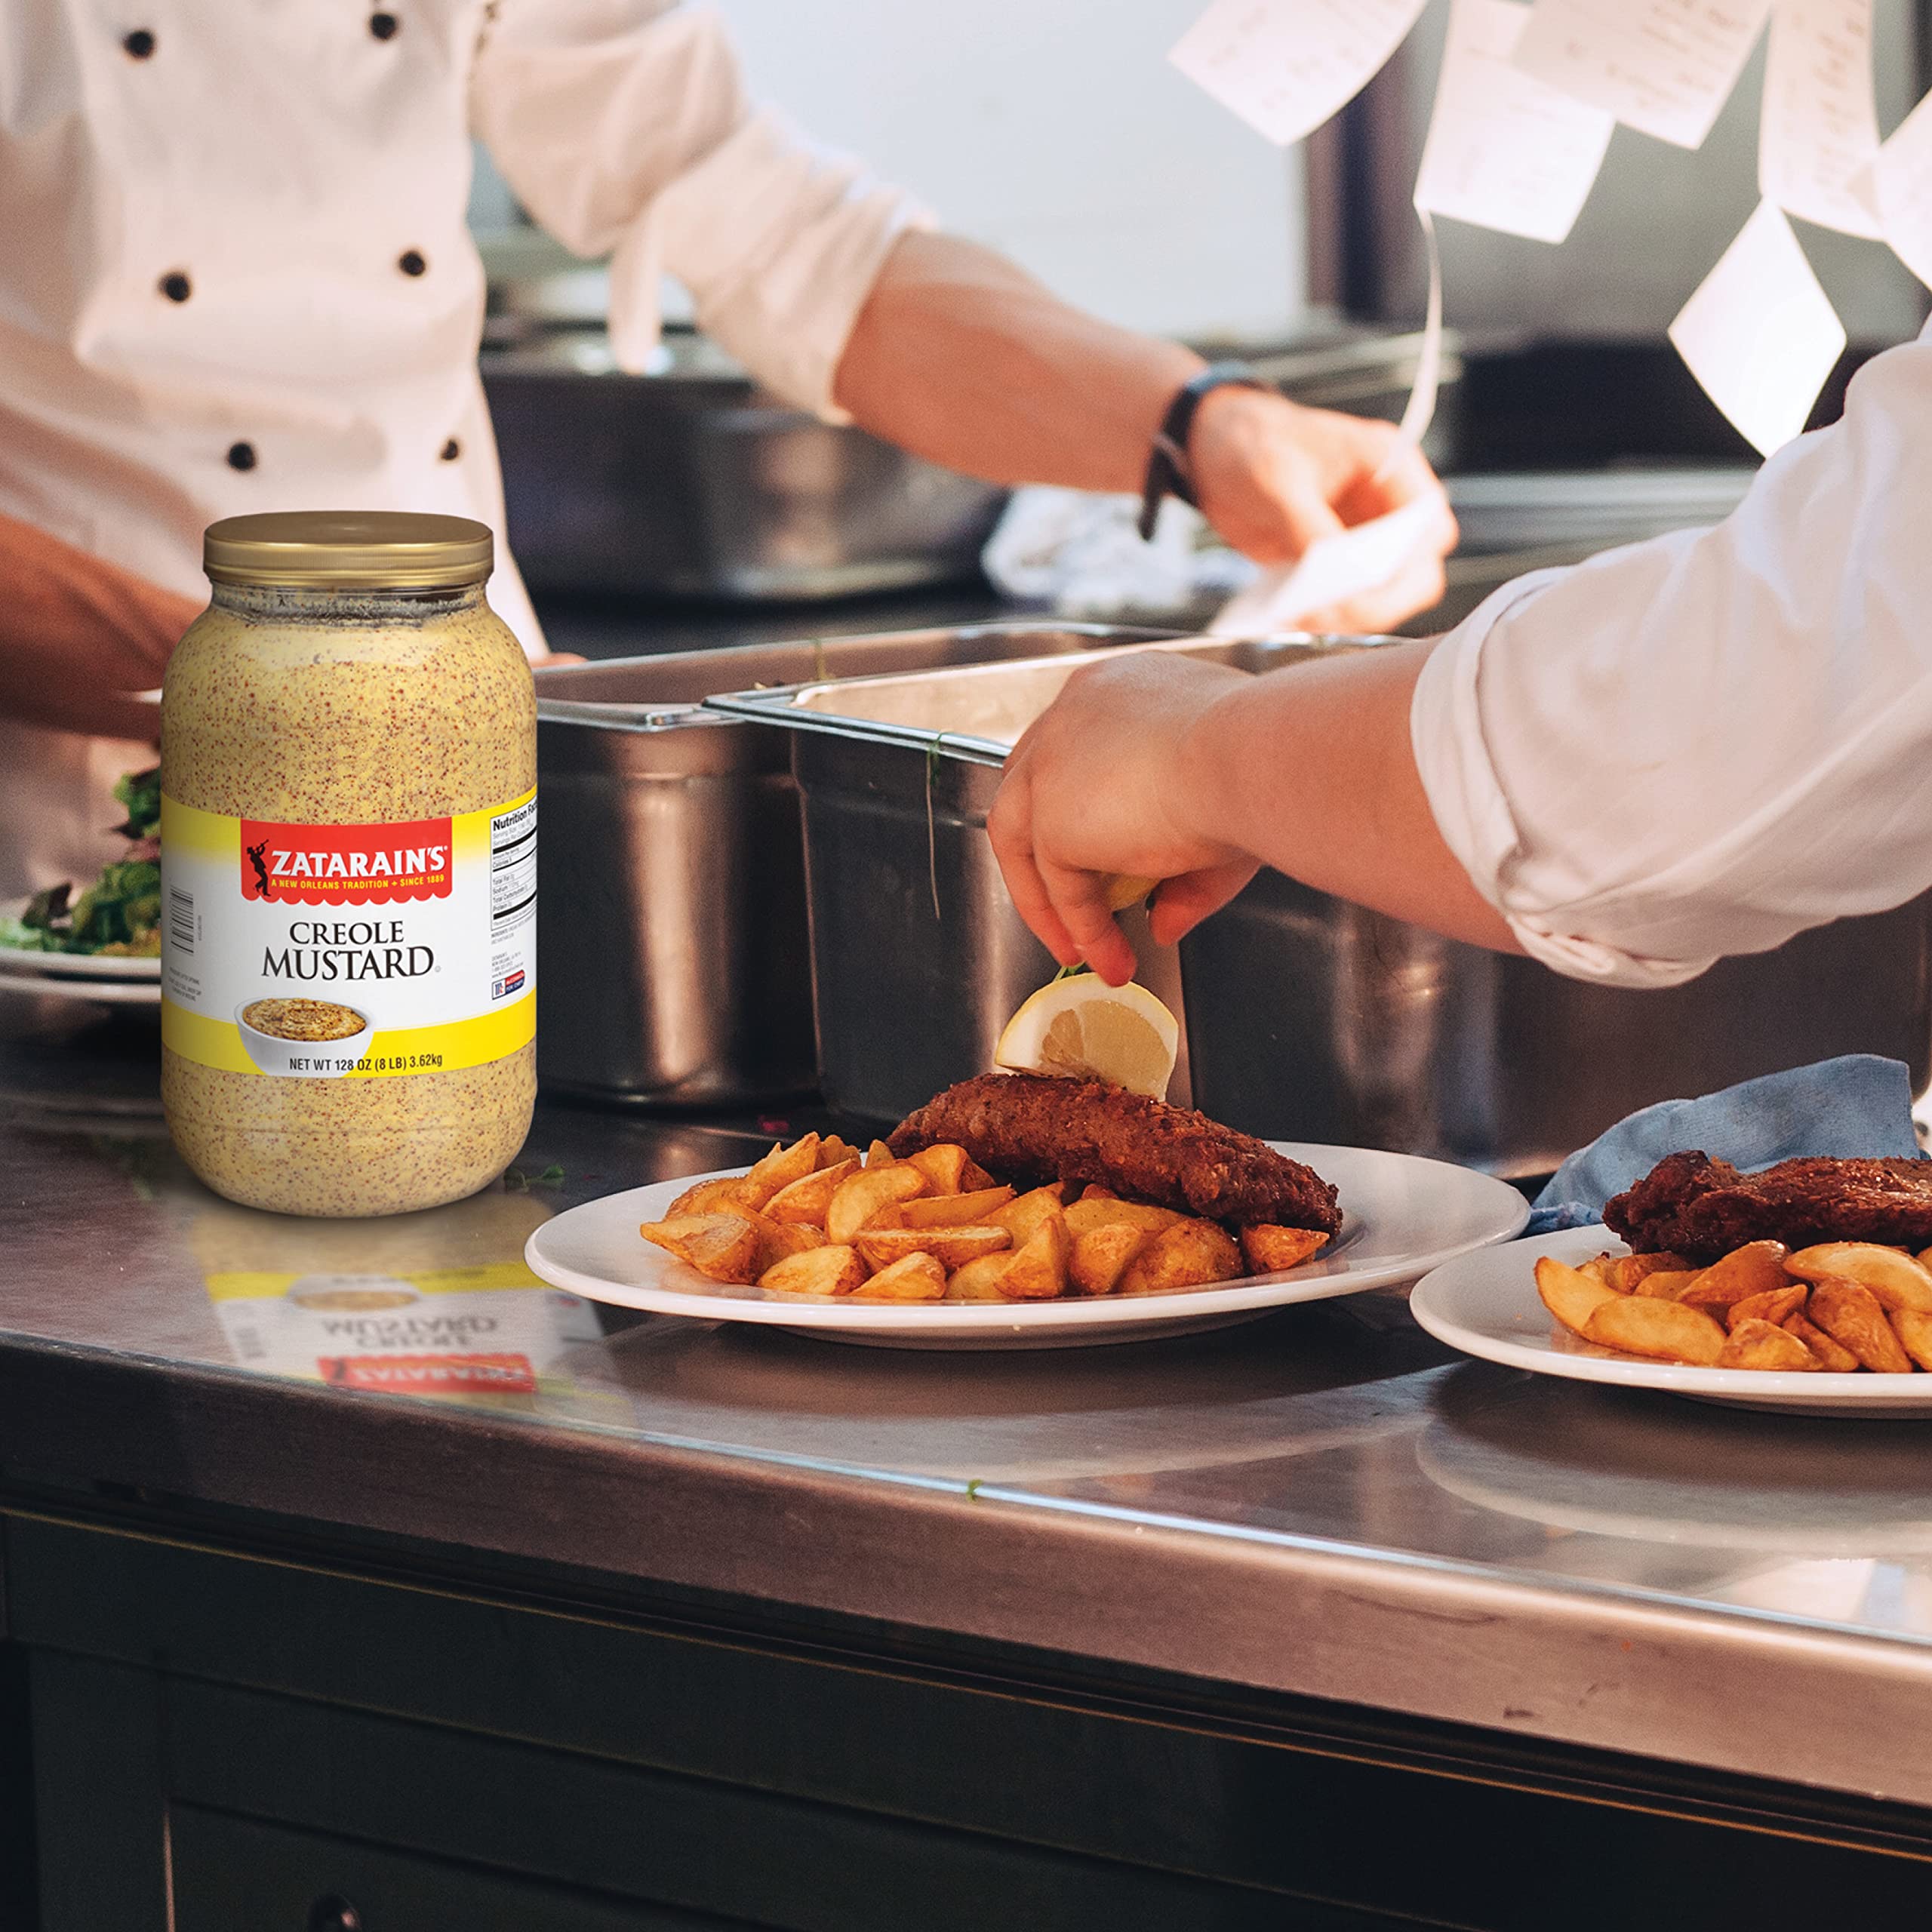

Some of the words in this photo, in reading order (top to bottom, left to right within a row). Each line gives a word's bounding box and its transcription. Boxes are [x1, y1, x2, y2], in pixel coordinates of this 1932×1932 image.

[493, 810, 527, 831] Nutrition
[271, 845, 445, 878] ZATARAIN'S
[272, 879, 277, 888] A
[279, 880, 297, 888] NEW
[300, 881, 340, 890] ORLEANS
[343, 880, 389, 889] TRADITION
[400, 877, 423, 887] SINCE
[427, 874, 445, 884] 1889
[289, 921, 405, 945] CREOLE
[261, 945, 435, 981] MUSTARD
[290, 1058, 310, 1071] NET
[313, 1059, 331, 1071] WT
[335, 1059, 354, 1071] 128
[357, 1058, 371, 1071] OZ
[374, 1058, 386, 1072] (8
[389, 1057, 407, 1069] LB)
[409, 1054, 442, 1068] 3.62kg
